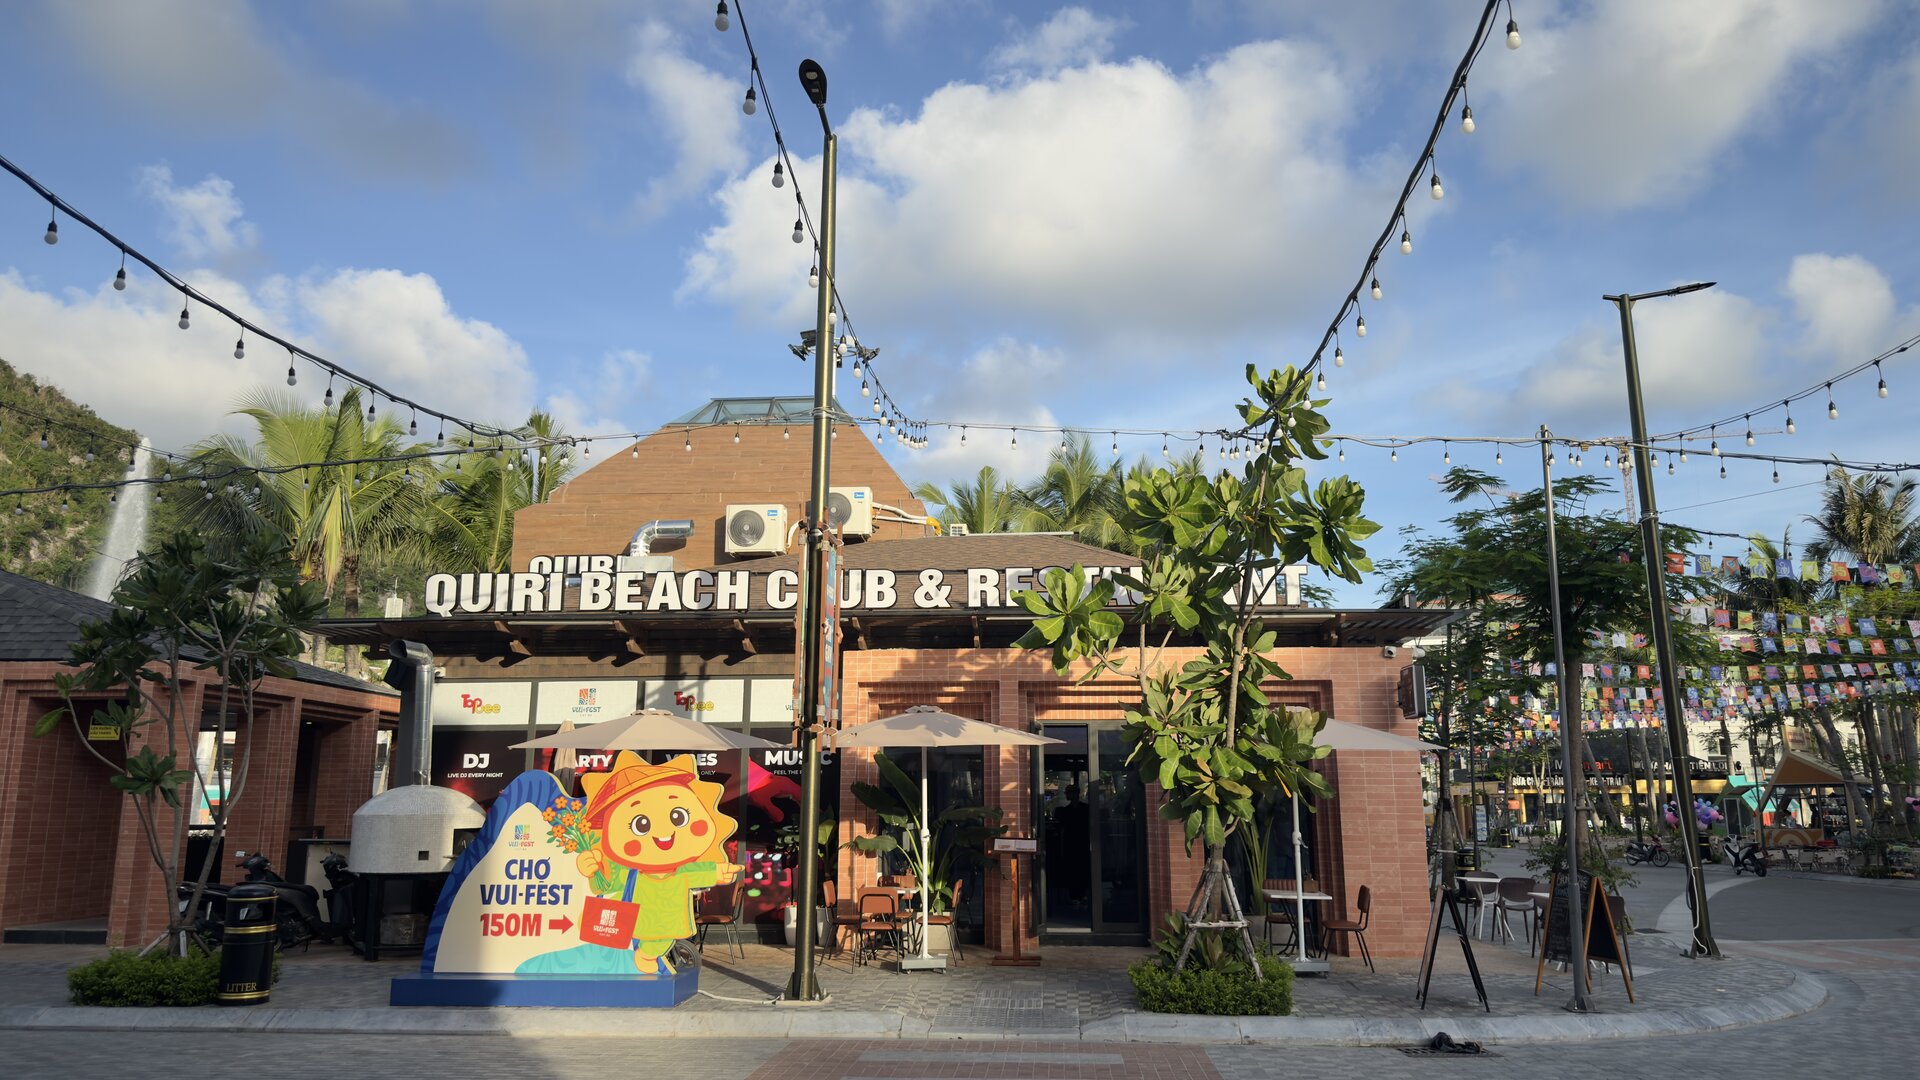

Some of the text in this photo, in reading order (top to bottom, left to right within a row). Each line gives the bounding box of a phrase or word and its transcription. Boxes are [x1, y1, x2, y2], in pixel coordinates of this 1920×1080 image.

[425, 572, 563, 617] QUIRI
[579, 570, 750, 611] BEACH
[766, 569, 897, 609] CUB
[913, 568, 952, 609] &
[463, 753, 490, 769] DJ
[575, 754, 613, 768] RTY
[665, 753, 718, 766] VES
[765, 749, 832, 766] MUC
[480, 884, 573, 905] VUI-FEST
[480, 913, 542, 936] 150M
[226, 982, 257, 992] LITTER
